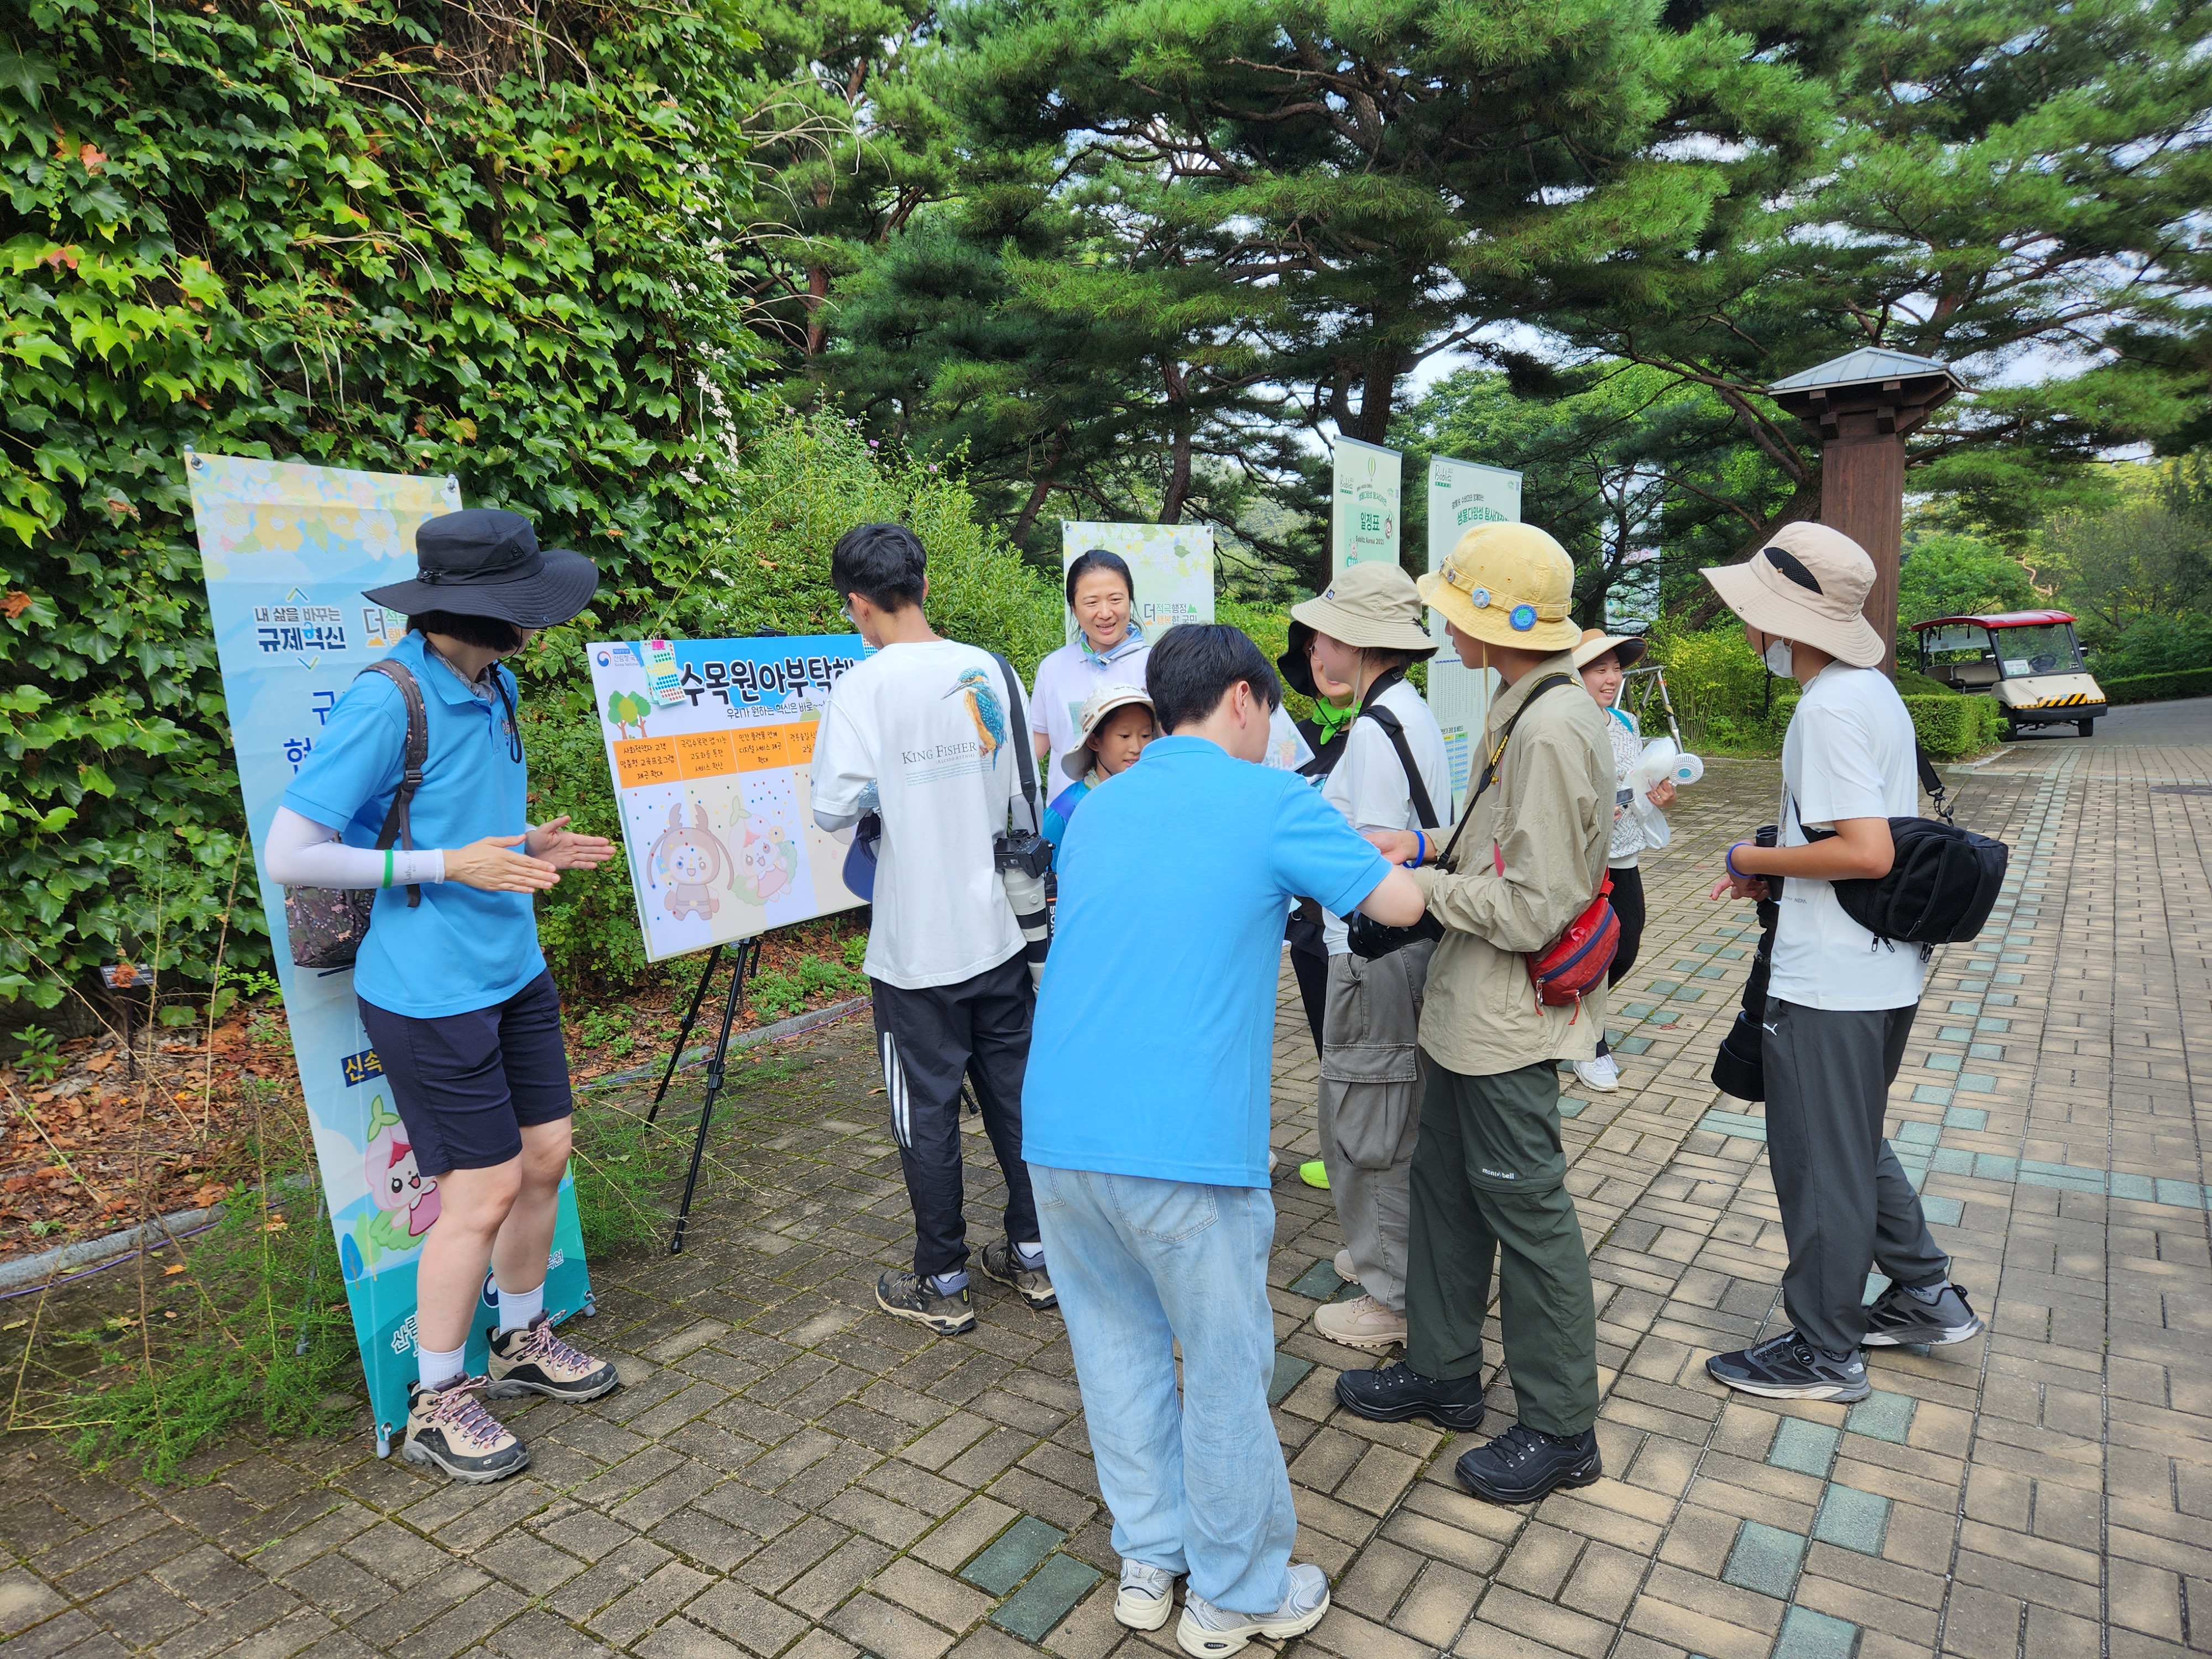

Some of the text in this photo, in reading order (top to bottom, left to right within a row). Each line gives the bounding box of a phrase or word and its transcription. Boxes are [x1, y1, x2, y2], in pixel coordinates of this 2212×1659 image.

[1361, 512, 1380, 531] 일정표
[1457, 507, 1483, 525] 생물다양성
[254, 607, 341, 622] 내 삶을 바꾸는
[1144, 603, 1187, 622] 더 적극행정
[363, 607, 387, 640] 더
[1156, 615, 1180, 625] 행복한
[257, 627, 347, 652] 규제혁신
[727, 707, 749, 719] 우리가
[752, 705, 774, 717] 원하는
[775, 703, 797, 714] 혁신은
[681, 735, 727, 748] 국립수목원 앱 기능
[739, 731, 778, 742] 민간 플랫폼 연계
[790, 732, 810, 742] 광릉숲길
[624, 743, 666, 754] 사회적약자 고객
[739, 742, 781, 753] 디지털 서비스 제공
[803, 744, 812, 753] 교실
[901, 742, 977, 764] KING FISHER
[690, 749, 723, 760] 고도화를 통한
[758, 756, 768, 764] 확대
[620, 754, 674, 769] 맞춤형 교육프로그램
[695, 764, 711, 772] 서비스
[637, 769, 663, 780] 제공 확대
[345, 1051, 383, 1082] 신속
